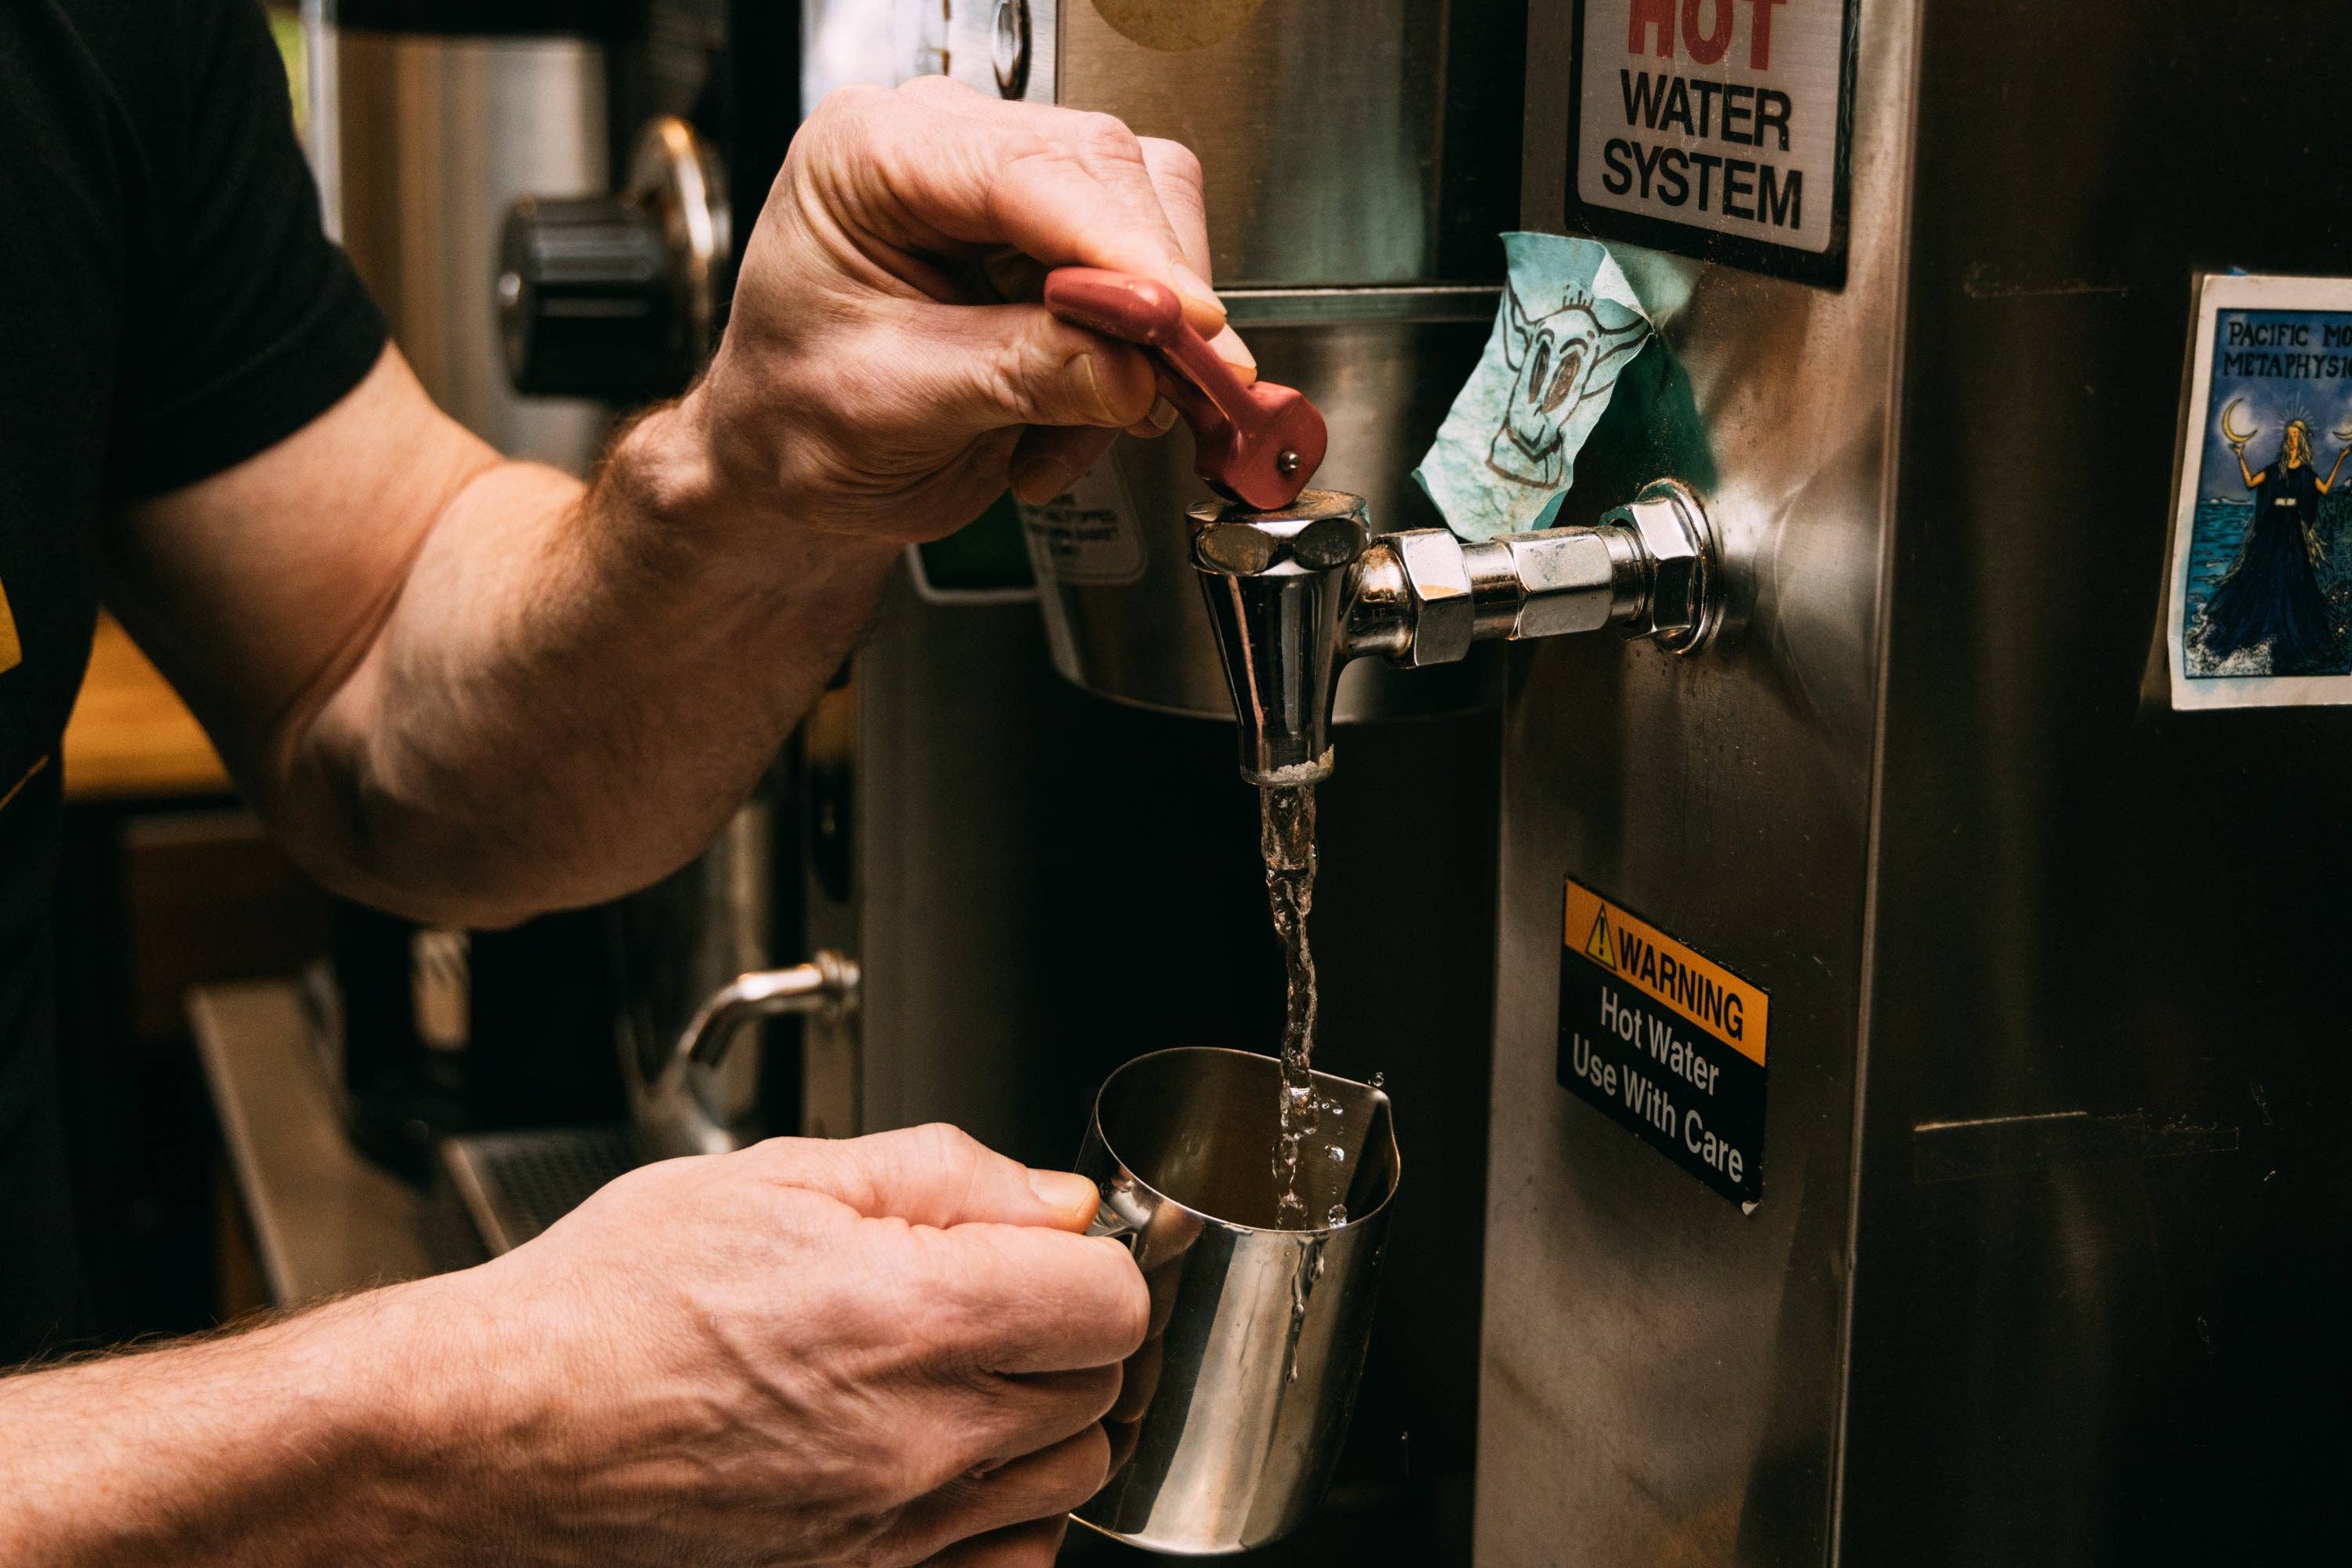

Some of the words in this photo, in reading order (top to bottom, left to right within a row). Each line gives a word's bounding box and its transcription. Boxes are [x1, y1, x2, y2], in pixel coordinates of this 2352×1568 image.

[1628, 0, 1787, 71] HOT
[1620, 68, 1791, 151] WATER
[1602, 138, 1802, 230] SYSTEM
[2228, 321, 2309, 347] PACIFIC
[1618, 927, 1744, 1041] WARNING
[1601, 985, 1642, 1049] Hot
[1648, 1014, 1719, 1096] Water
[1573, 1033, 1617, 1097] Use
[1624, 1064, 1675, 1139] With
[1685, 1109, 1743, 1184] Care
